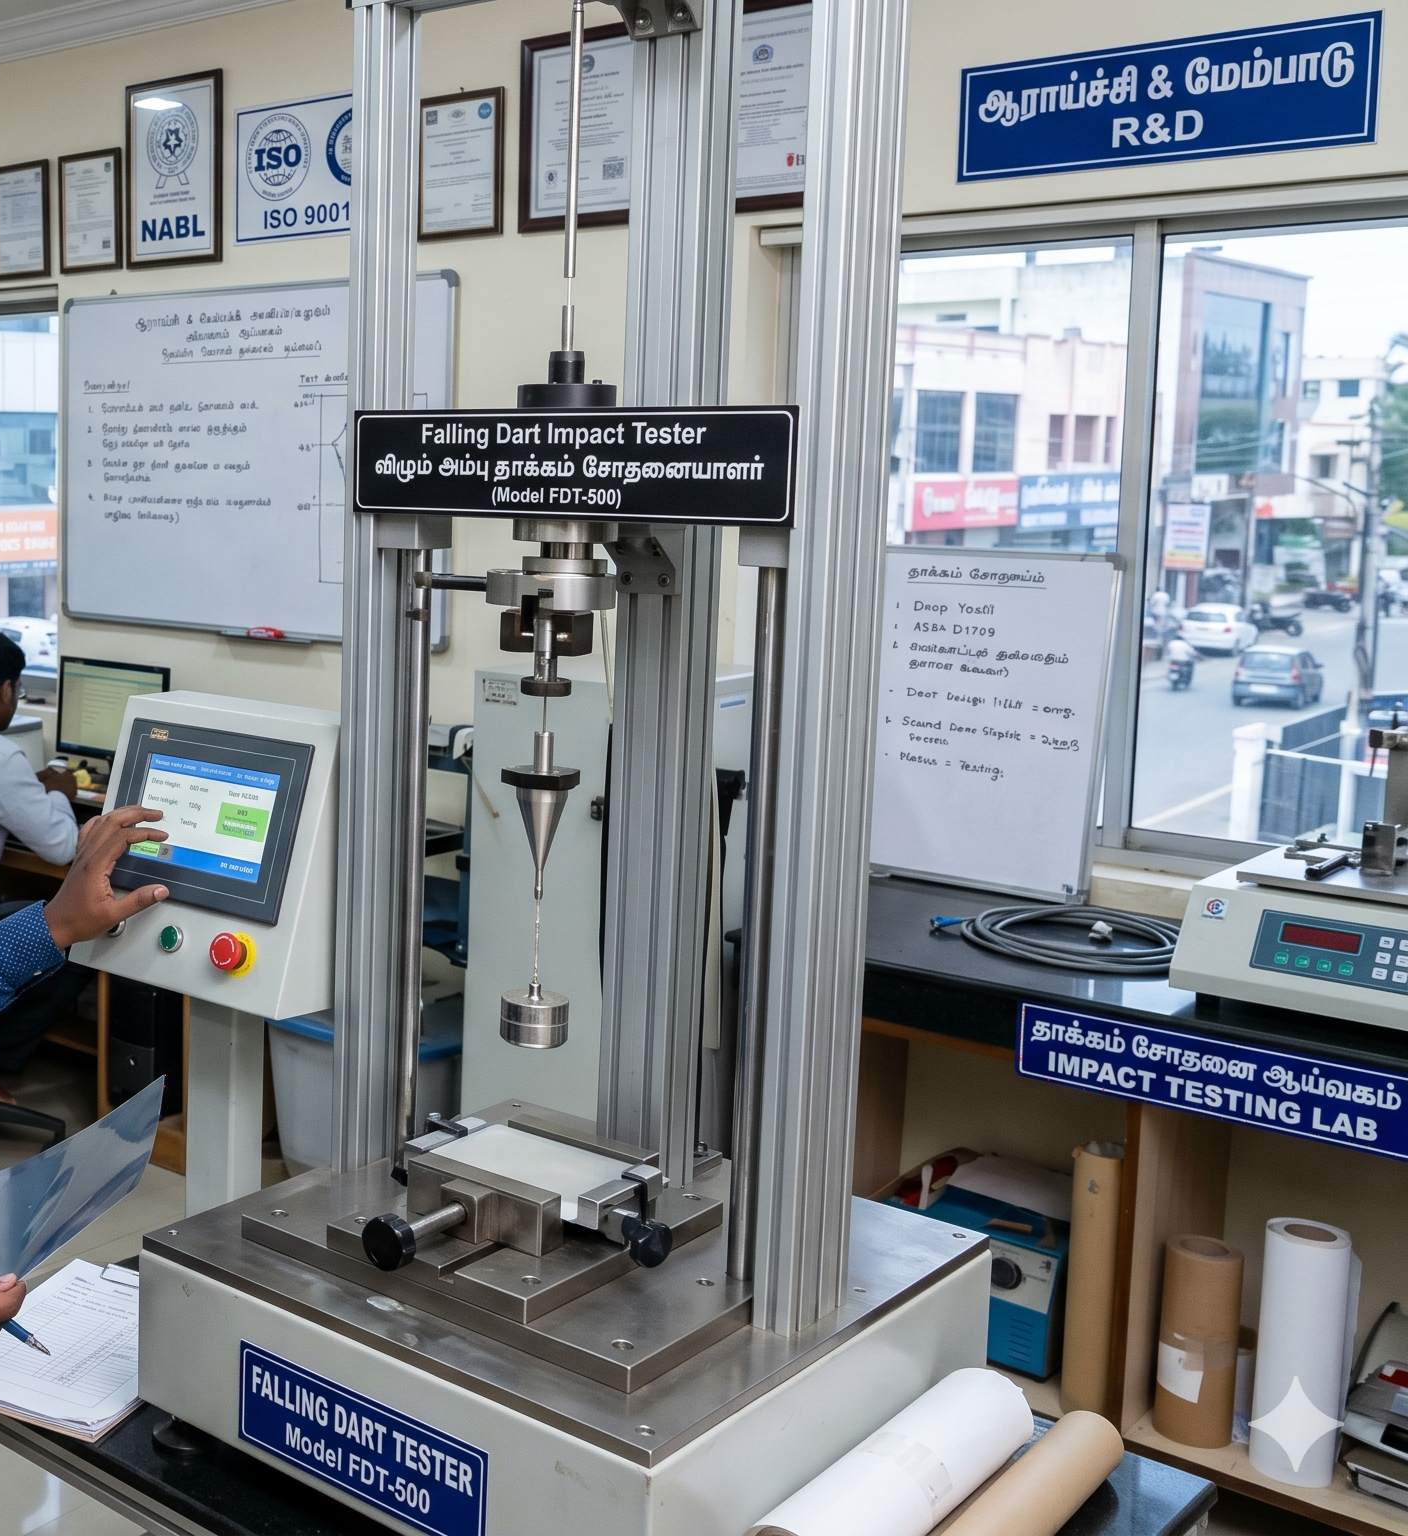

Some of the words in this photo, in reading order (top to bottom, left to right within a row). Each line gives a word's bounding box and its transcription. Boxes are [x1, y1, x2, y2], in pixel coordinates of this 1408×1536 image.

[978, 65, 1138, 128] ஆராய்ச்சி
[1147, 65, 1174, 101] &
[1184, 41, 1355, 95] மேம்பாடு
[1111, 109, 1204, 148] R&D
[254, 144, 302, 172] ISO
[141, 214, 205, 242] NABL
[264, 207, 297, 230] ISO
[305, 201, 350, 226] 9001
[421, 422, 489, 449] Falling
[497, 423, 541, 446] Dart
[547, 422, 625, 450] Impact
[632, 422, 706, 445] Tester
[375, 453, 433, 482] விழும்
[438, 454, 489, 481] அம்பு
[494, 454, 575, 482] தாக்கம்
[582, 454, 765, 484] சோதனையாளர்
[491, 487, 544, 507] (Model
[549, 488, 622, 509] FDT-500)
[953, 624, 995, 637] D1709
[1030, 1020, 1125, 1054] தாக்கம்
[1132, 1035, 1257, 1081] சோதனை
[1263, 1066, 1401, 1110] ஆய்வகம்
[1048, 1051, 1156, 1093] IMPACT
[1165, 1076, 1301, 1125] TESTING
[1312, 1108, 1378, 1142] LAB
[251, 1365, 328, 1427] FALLING
[334, 1405, 387, 1455] DART
[393, 1430, 473, 1497] TESTER
[285, 1423, 342, 1472] Model
[349, 1454, 430, 1515] FDT-500
